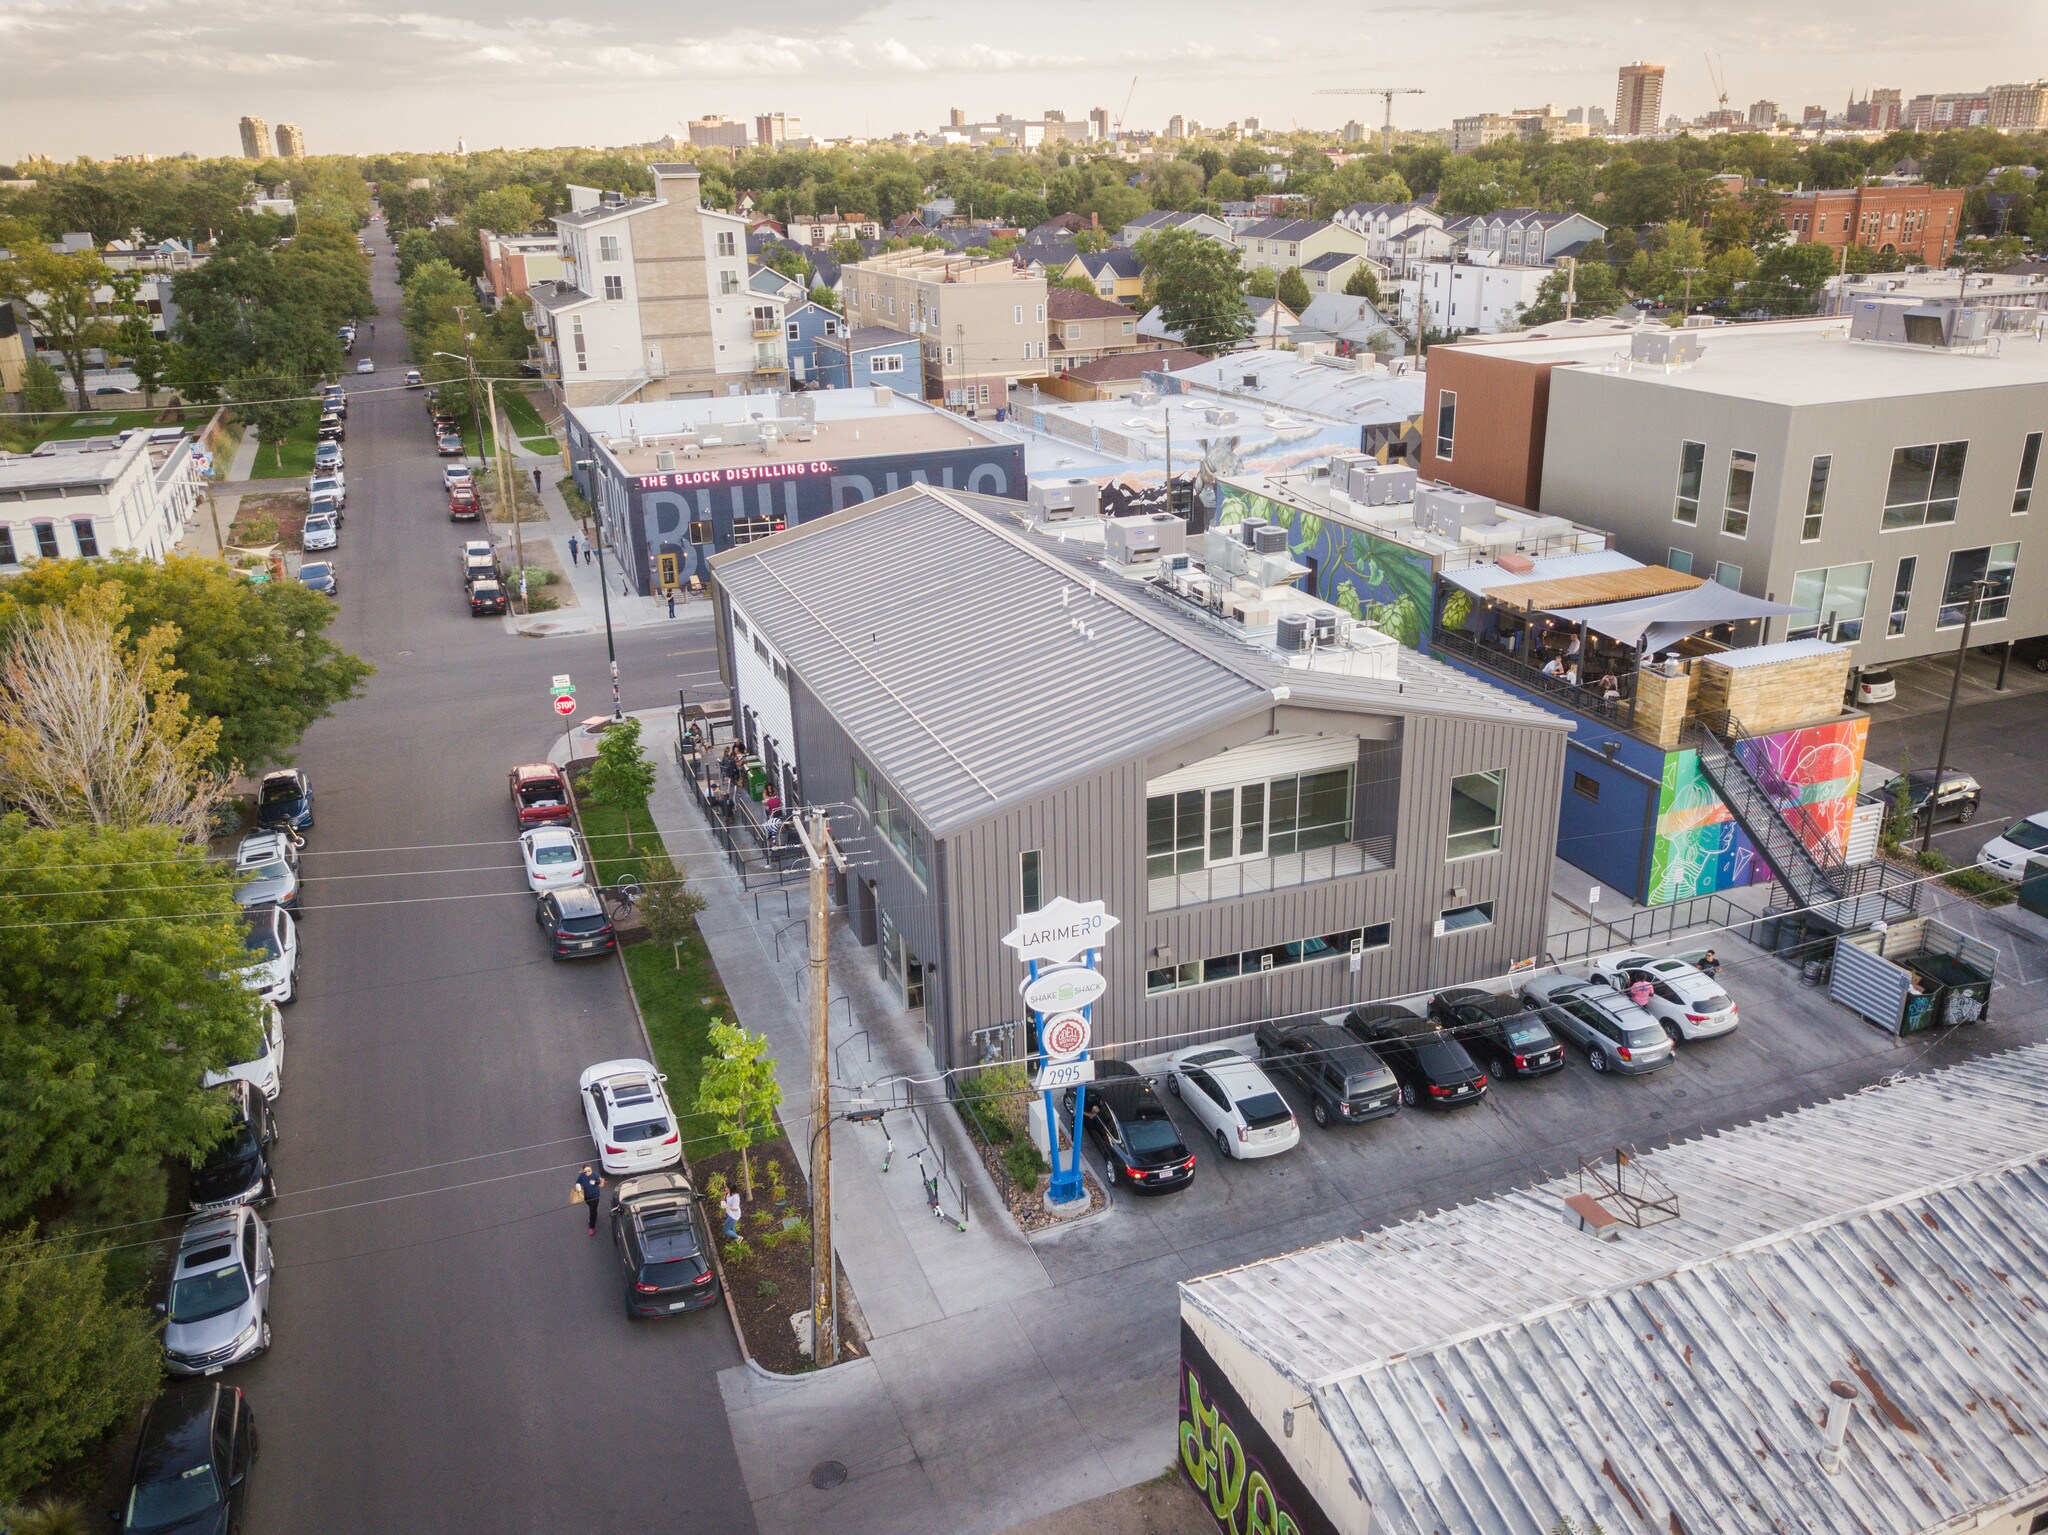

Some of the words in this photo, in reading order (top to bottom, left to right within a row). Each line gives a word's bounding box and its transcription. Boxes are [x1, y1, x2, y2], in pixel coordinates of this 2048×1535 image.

[640, 475, 667, 488] THE
[675, 471, 720, 485] BLOCK
[726, 464, 805, 480] DISTILLING
[811, 461, 832, 473] CO.
[556, 701, 574, 710] STOP
[1030, 991, 1057, 1004] SHAKE
[1074, 983, 1101, 995] SHACK
[1059, 1026, 1077, 1041] ODELL
[1049, 1065, 1080, 1086] 2995
